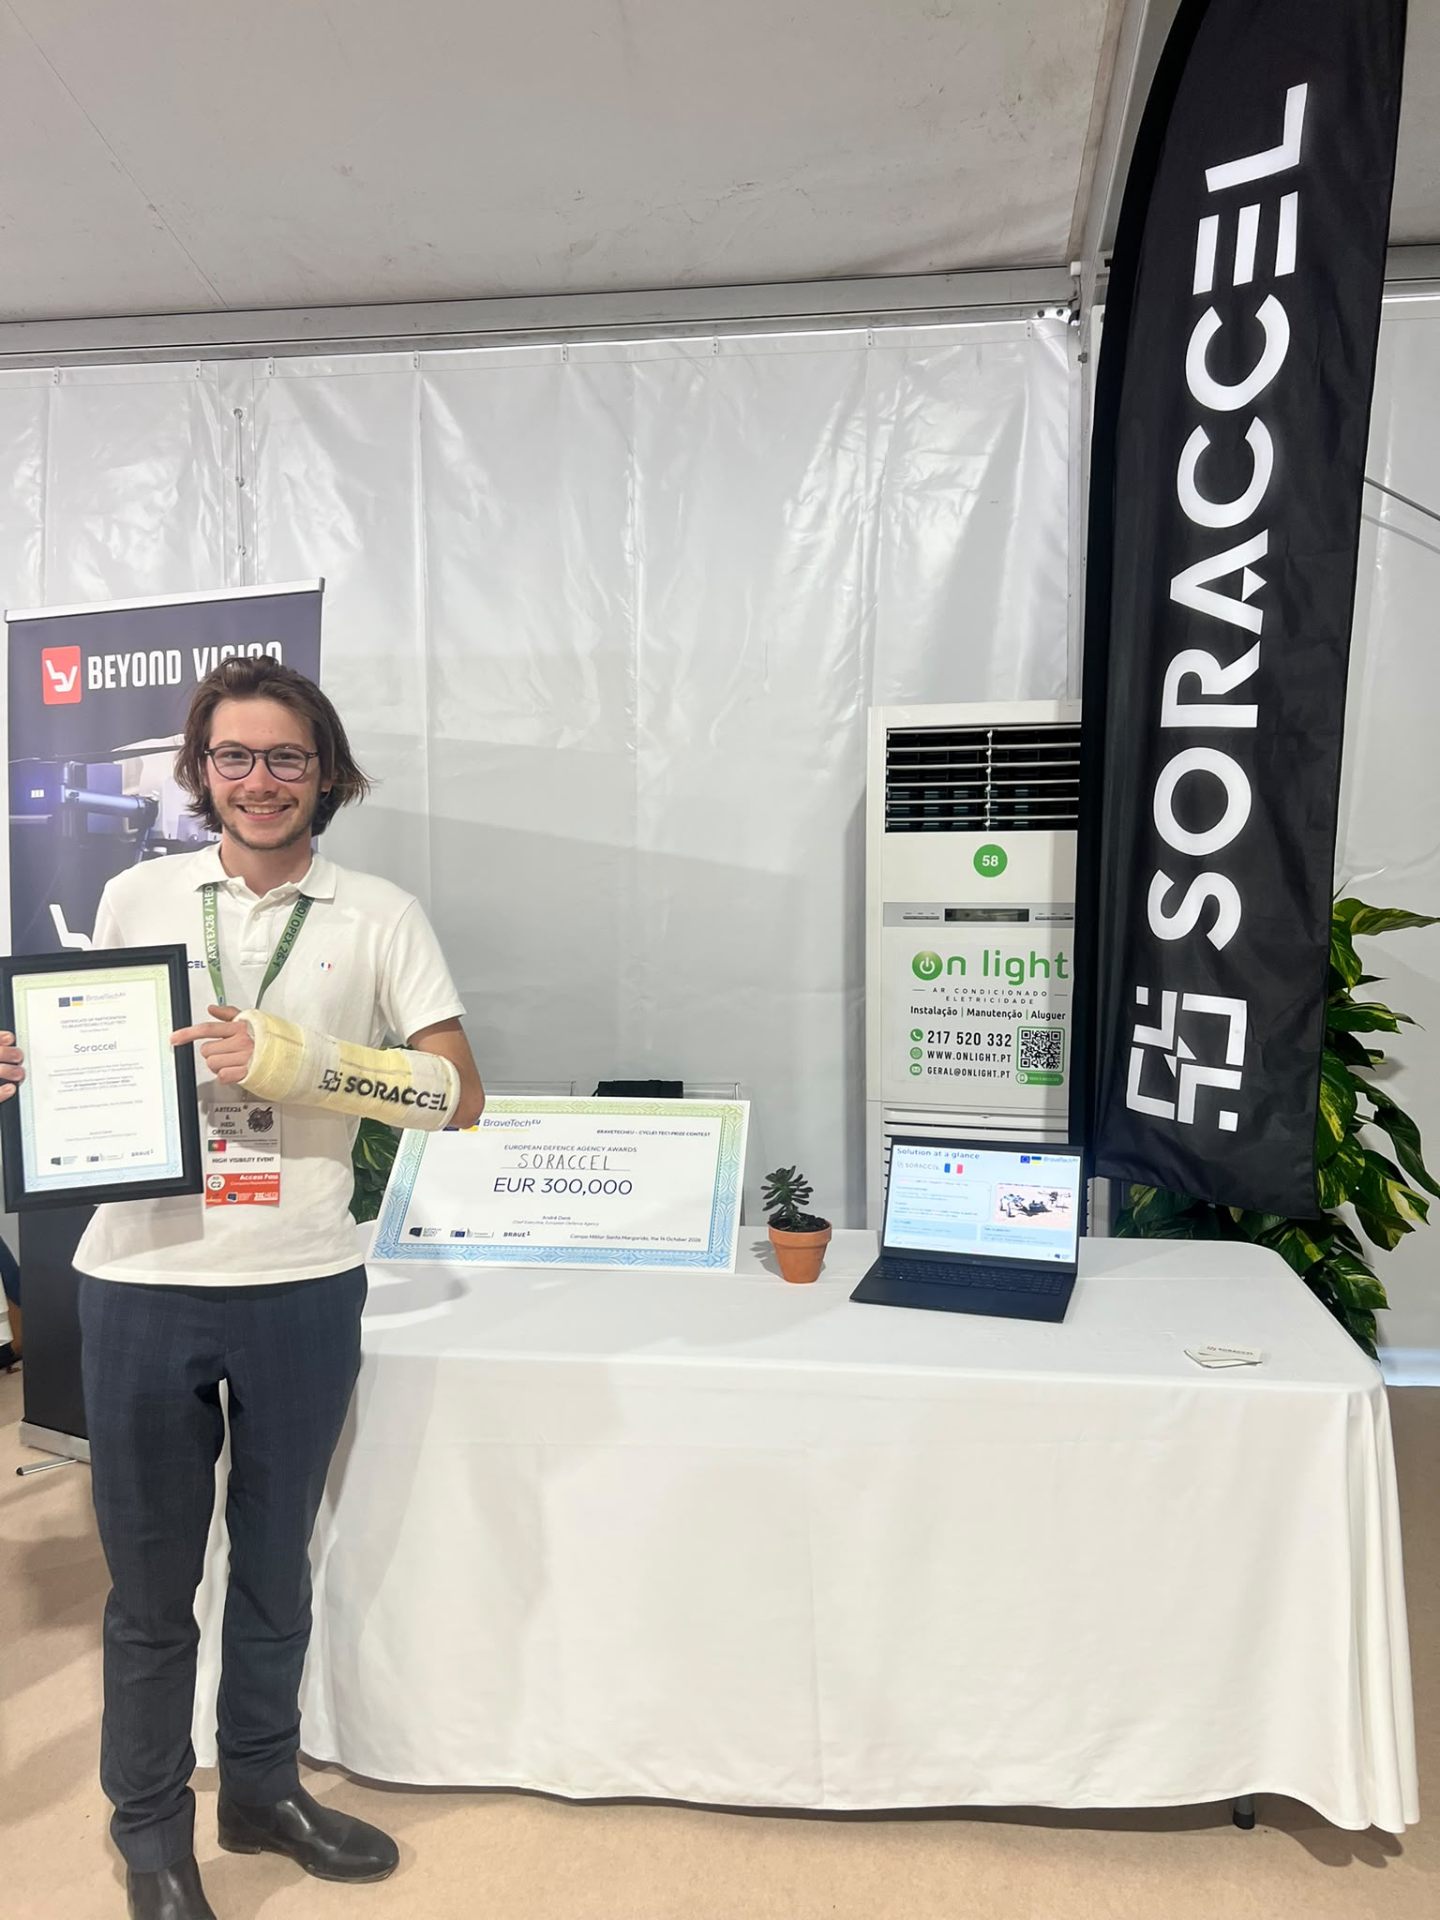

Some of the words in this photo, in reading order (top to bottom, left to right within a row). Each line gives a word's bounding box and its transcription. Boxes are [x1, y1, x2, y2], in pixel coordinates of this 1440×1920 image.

[1148, 83, 1308, 950] SORACCEL
[88, 650, 182, 690] BEYOND
[982, 855, 999, 867] 58
[205, 914, 218, 959] ARTEX26
[281, 919, 301, 946] OPEX
[983, 949, 1069, 986] light
[946, 996, 1034, 1005] ELETRICIDADE
[954, 987, 1048, 997] CONDICIONADO
[910, 1005, 958, 1017] Instalação
[966, 1008, 1023, 1020] Manutenção
[1030, 1010, 1066, 1021] Aluguer
[73, 1040, 118, 1054] Soraccel
[927, 1030, 951, 1044] 217
[956, 1031, 982, 1046] 520
[987, 1033, 1012, 1048] 332
[927, 1050, 1012, 1063] WWW.ONLIGHT.PT
[927, 1066, 1011, 1079] GERAL@ONLIGHT.PT
[344, 1076, 449, 1111] SORACCEL
[517, 1153, 611, 1171] SORACCEL
[897, 1148, 932, 1157] Solution
[951, 1152, 981, 1160] glance
[493, 1177, 536, 1193] EUR
[540, 1177, 633, 1196] 300,000
